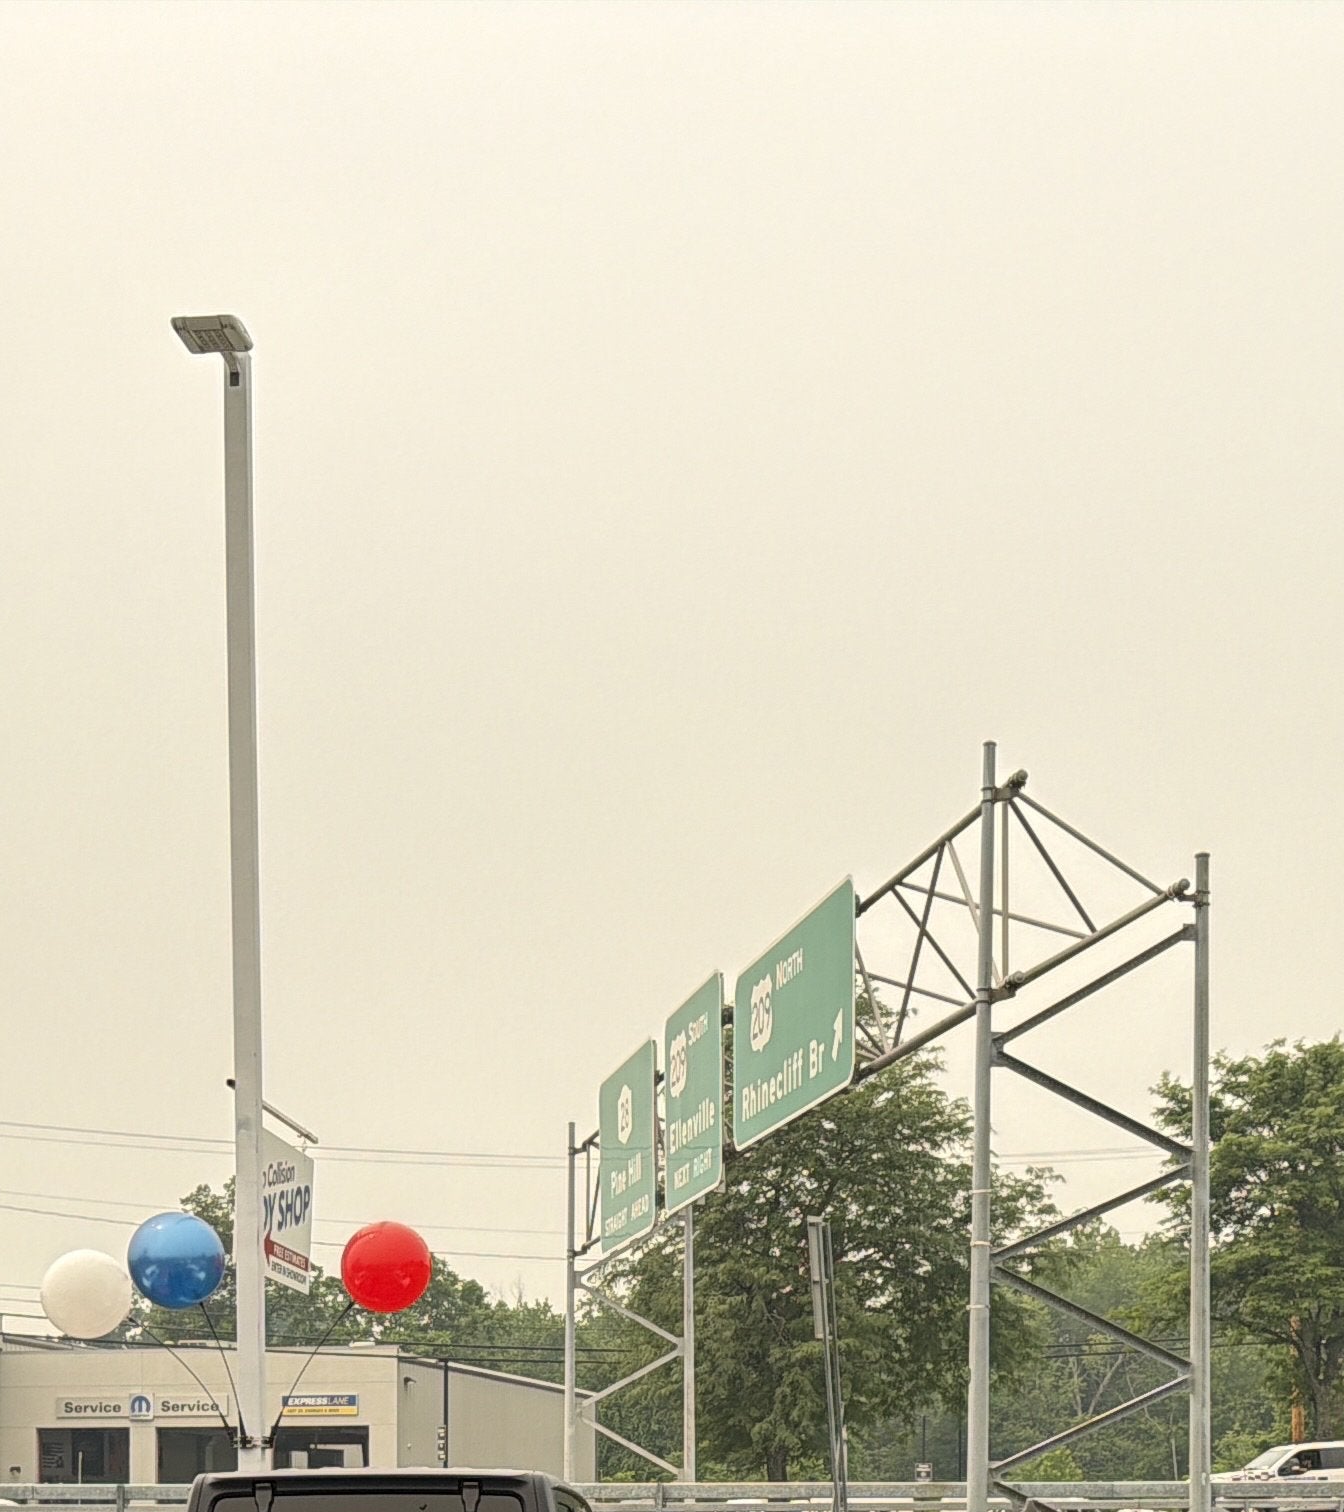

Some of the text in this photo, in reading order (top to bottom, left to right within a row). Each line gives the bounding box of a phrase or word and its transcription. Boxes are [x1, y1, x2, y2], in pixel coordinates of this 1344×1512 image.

[776, 948, 804, 991] NORTH
[752, 991, 771, 1041] 209
[741, 1039, 825, 1123] Rhinecliff Br
[669, 1097, 716, 1155] Ellenville
[268, 1160, 296, 1188] Collision
[278, 1184, 311, 1232] SHOP
[64, 1400, 220, 1414] Service Service
